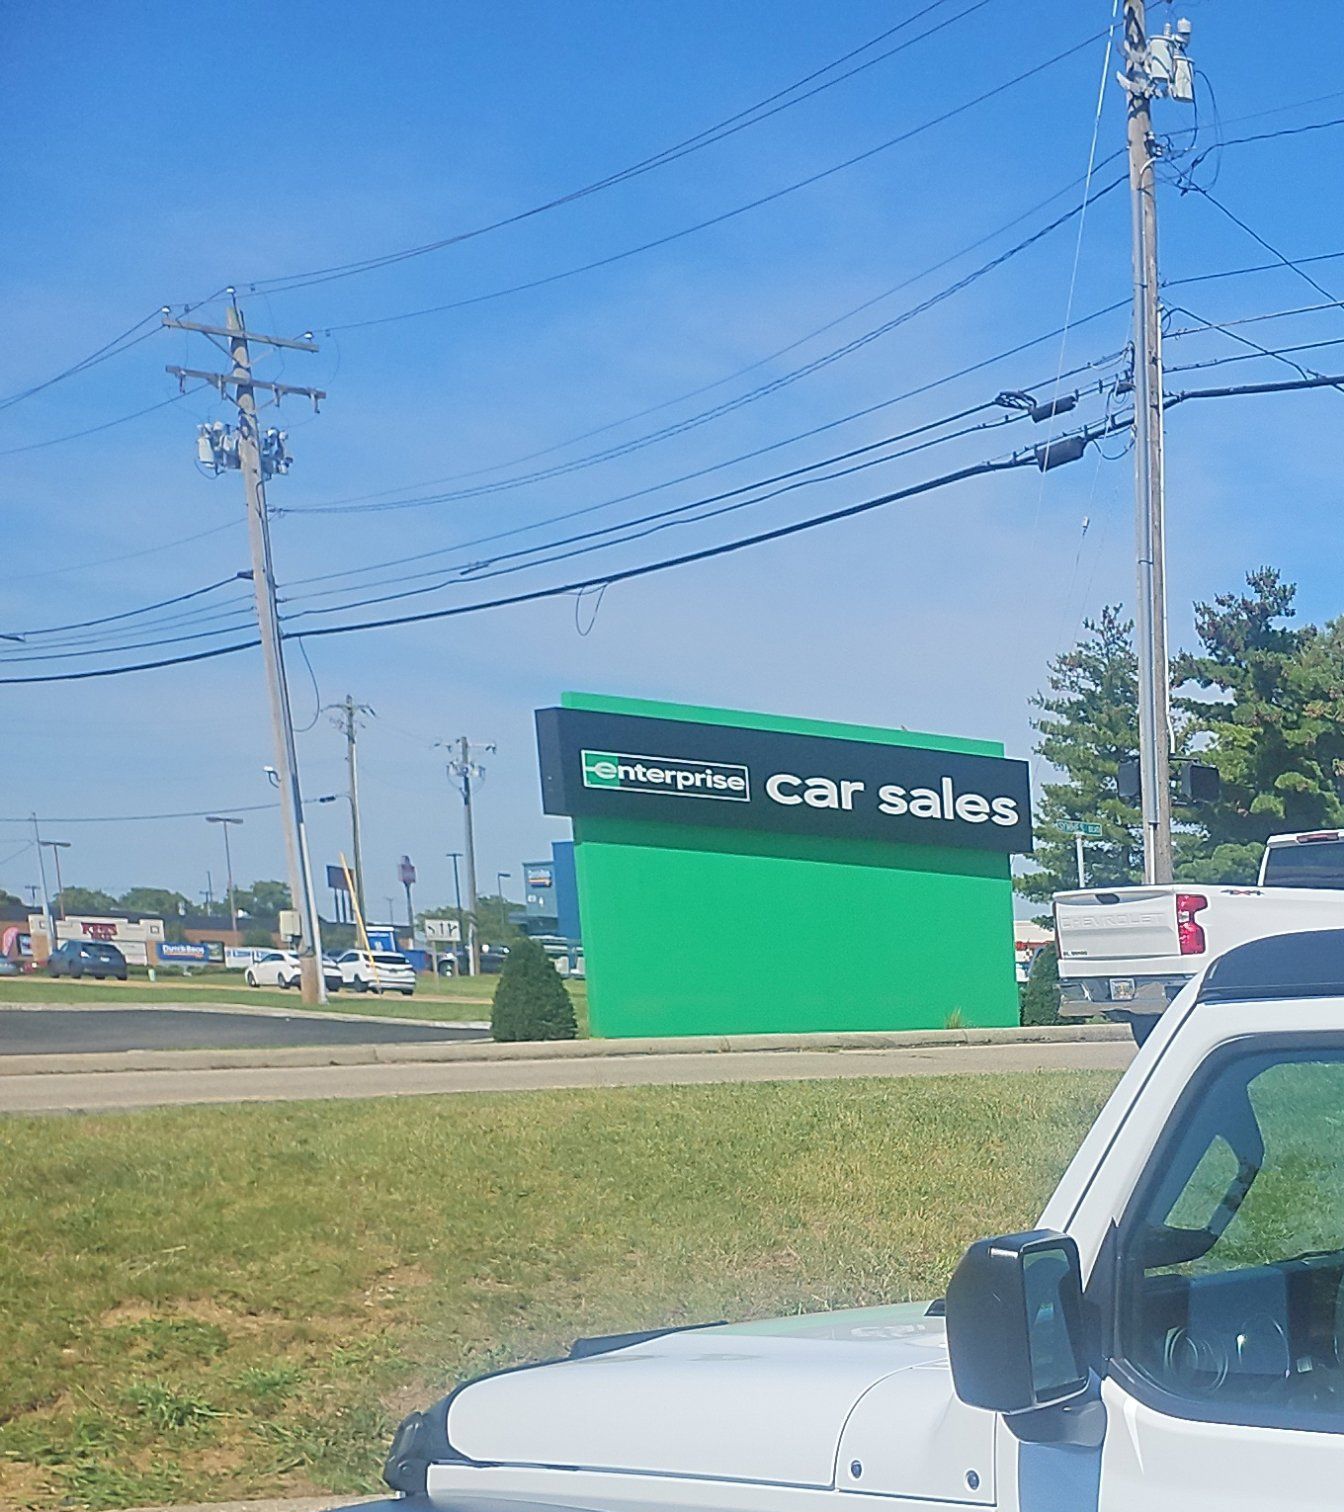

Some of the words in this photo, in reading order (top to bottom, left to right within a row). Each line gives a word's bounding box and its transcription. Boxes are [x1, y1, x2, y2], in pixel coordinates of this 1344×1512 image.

[591, 760, 747, 791] enterprise
[764, 773, 866, 811] car
[877, 775, 1021, 827] sales
